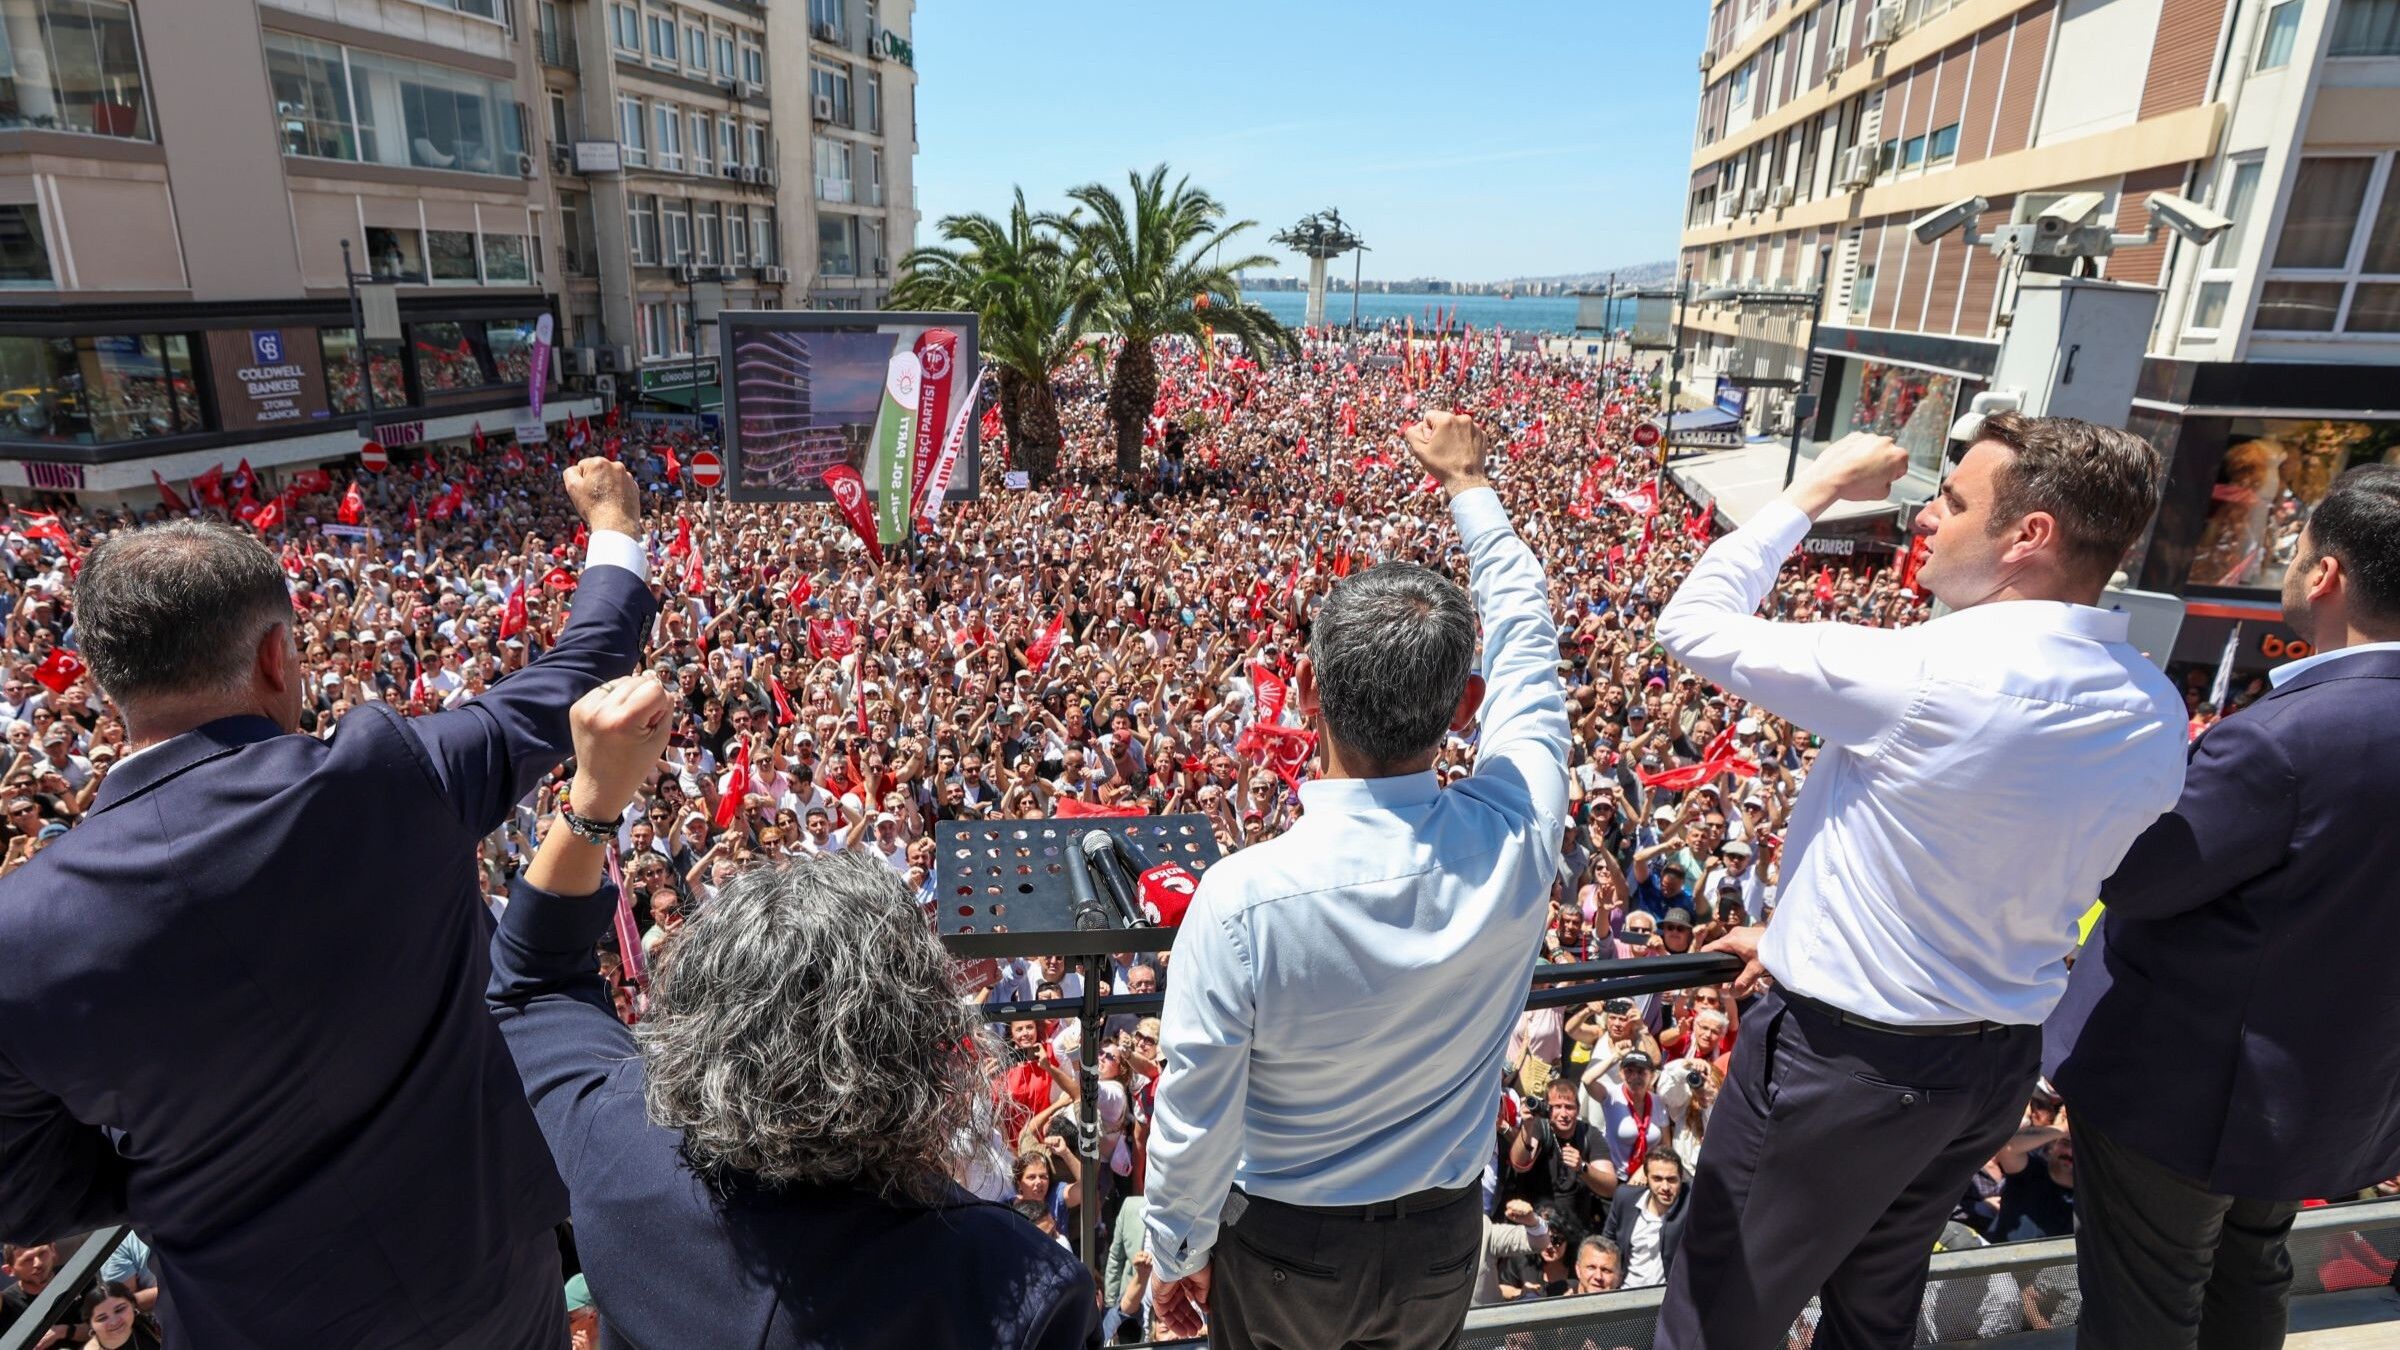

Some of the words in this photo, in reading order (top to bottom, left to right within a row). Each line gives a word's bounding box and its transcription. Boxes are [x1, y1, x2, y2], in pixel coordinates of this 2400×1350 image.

[238, 365, 304, 381] COLDWELL
[248, 379, 299, 394] BANKER
[922, 384, 936, 431] PARTİSİ
[916, 433, 932, 457] İŞÇİ
[20, 460, 85, 489] TWIGY
[1804, 538, 1855, 555] KUMRU
[2262, 634, 2316, 659] bo
